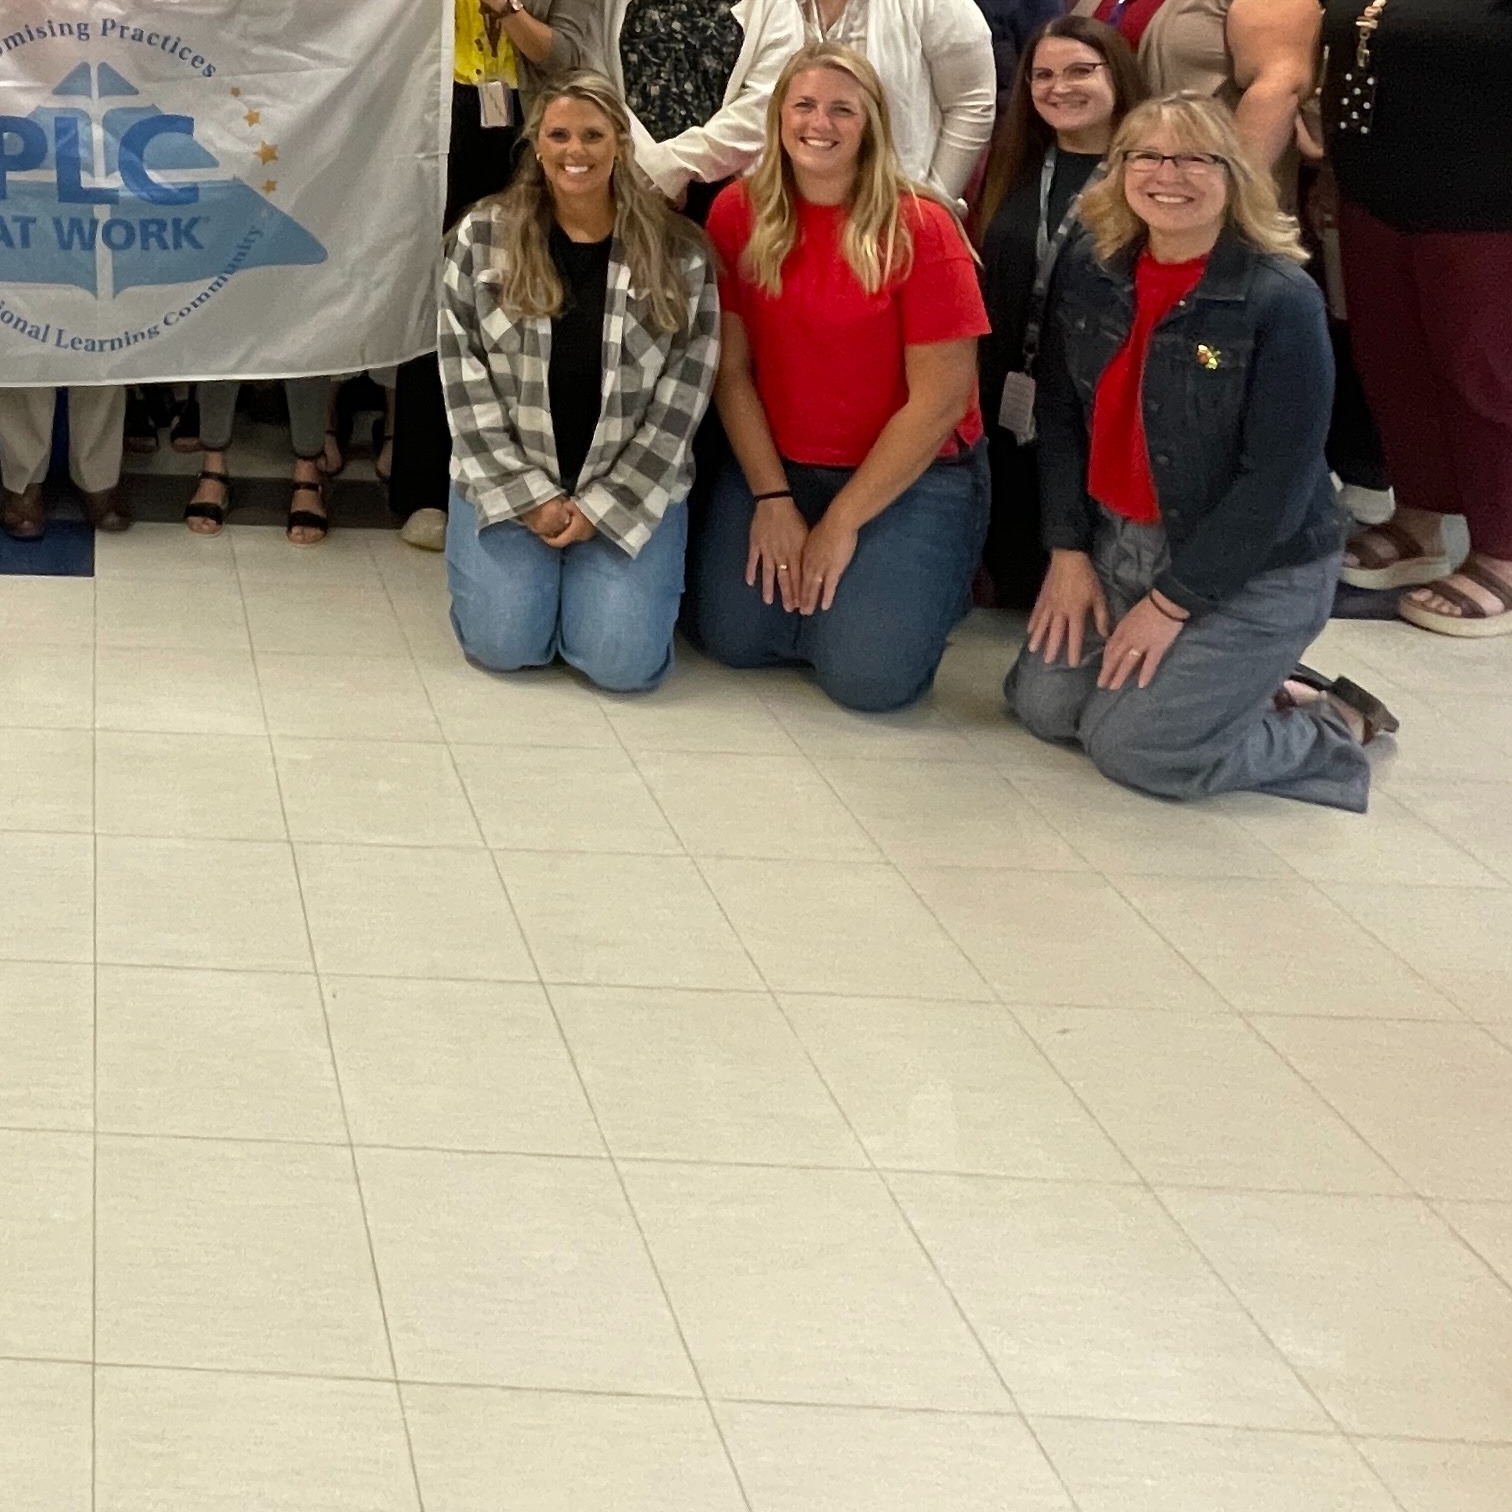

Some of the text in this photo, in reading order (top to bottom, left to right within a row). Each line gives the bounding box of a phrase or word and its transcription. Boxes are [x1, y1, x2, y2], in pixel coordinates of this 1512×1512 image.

[101, 18, 217, 78] Practices
[52, 216, 205, 251] WORK
[55, 324, 161, 353] Learning
[163, 225, 264, 326] Community
